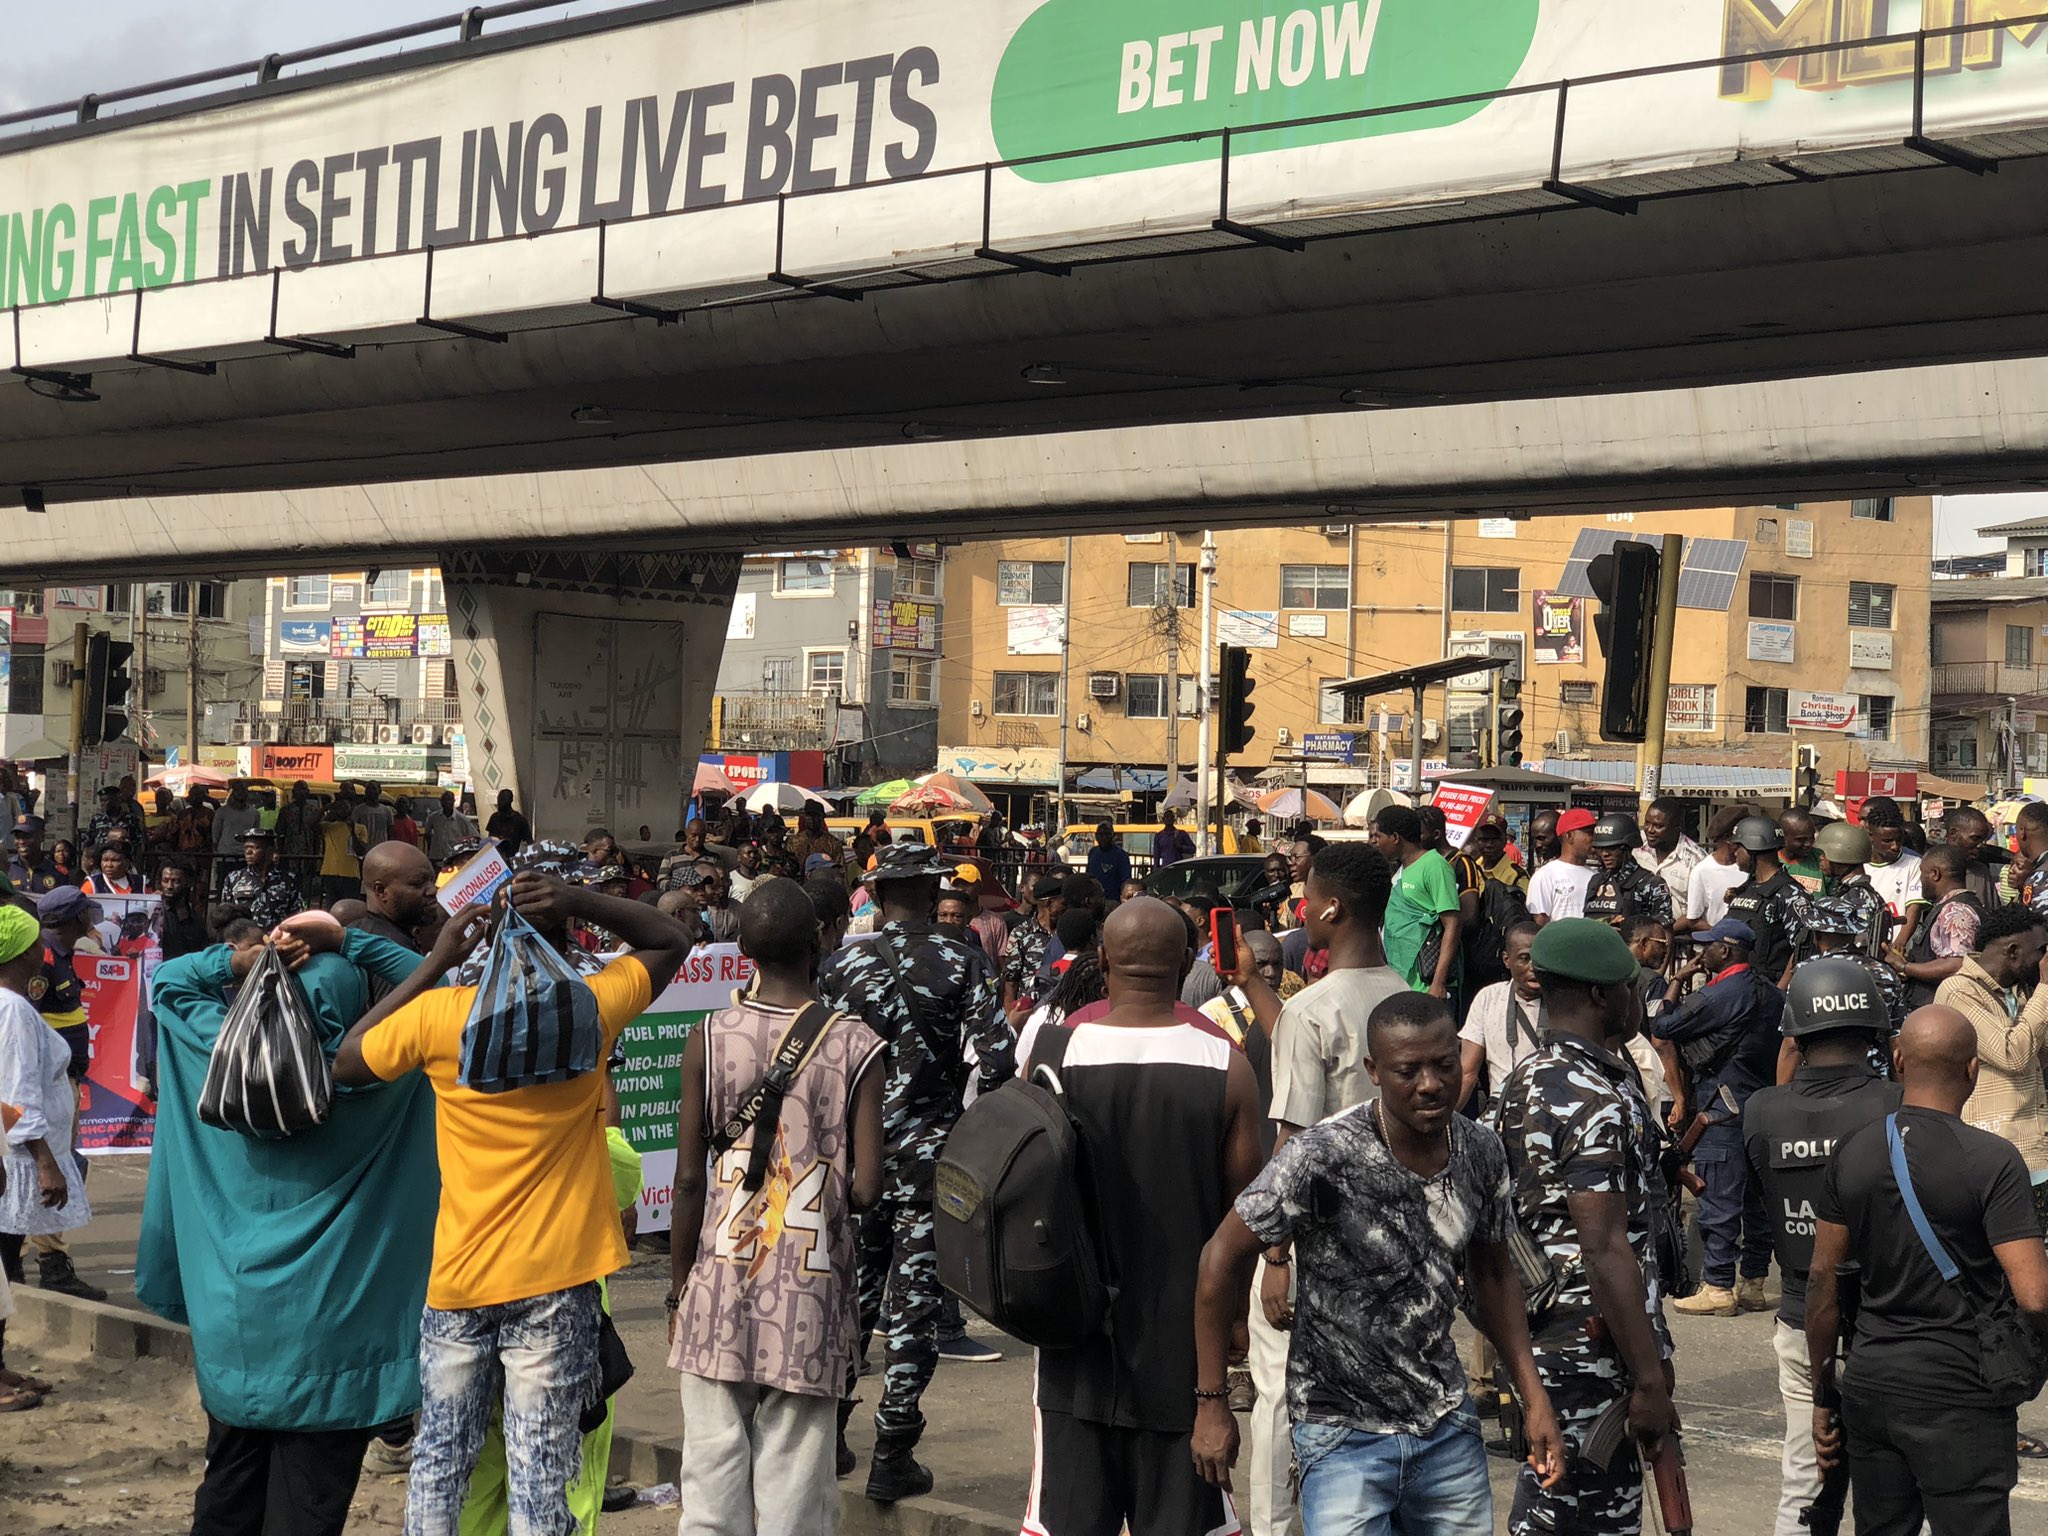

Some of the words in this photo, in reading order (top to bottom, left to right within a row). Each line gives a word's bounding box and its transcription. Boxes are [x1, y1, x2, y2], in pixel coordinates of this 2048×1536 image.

[1117, 25, 1224, 114] BET
[1234, 0, 1382, 95] NOW
[84, 179, 211, 295] FAST
[218, 167, 272, 283] IN
[283, 112, 568, 271] SETTLING
[578, 82, 734, 223] LIVE
[742, 46, 940, 200] BETS
[366, 615, 416, 637] CITADEL
[1671, 687, 1699, 699] BIBLE
[1669, 700, 1699, 711] BOOK
[1801, 701, 1845, 712] Christian
[1670, 713, 1699, 724] SHOP
[1800, 709, 1823, 718] Book
[1825, 711, 1845, 721] Shop
[1305, 740, 1352, 751] PHARMACY
[212, 759, 237, 767] SHOP
[728, 765, 768, 780] SPORTS
[1500, 783, 1532, 792] TRAFFIC
[1534, 784, 1565, 792] OFFICER
[1681, 789, 1729, 798] SPORTS
[1736, 789, 1761, 797] LTD.
[1594, 825, 1614, 835] OLICE
[448, 860, 502, 912] NATIONALISED
[1586, 900, 1617, 909] POLICE
[671, 956, 715, 984] ASS
[1812, 993, 1870, 1013] POLICE
[624, 1026, 655, 1042] FUEL
[624, 1053, 683, 1072] NEO-LIBE
[620, 1104, 636, 1120] IN
[632, 1126, 647, 1142] IN
[650, 1122, 674, 1139] THE
[1781, 1139, 1838, 1160] POLI
[641, 1184, 676, 1207] Vict
[715, 1146, 832, 1277] 24
